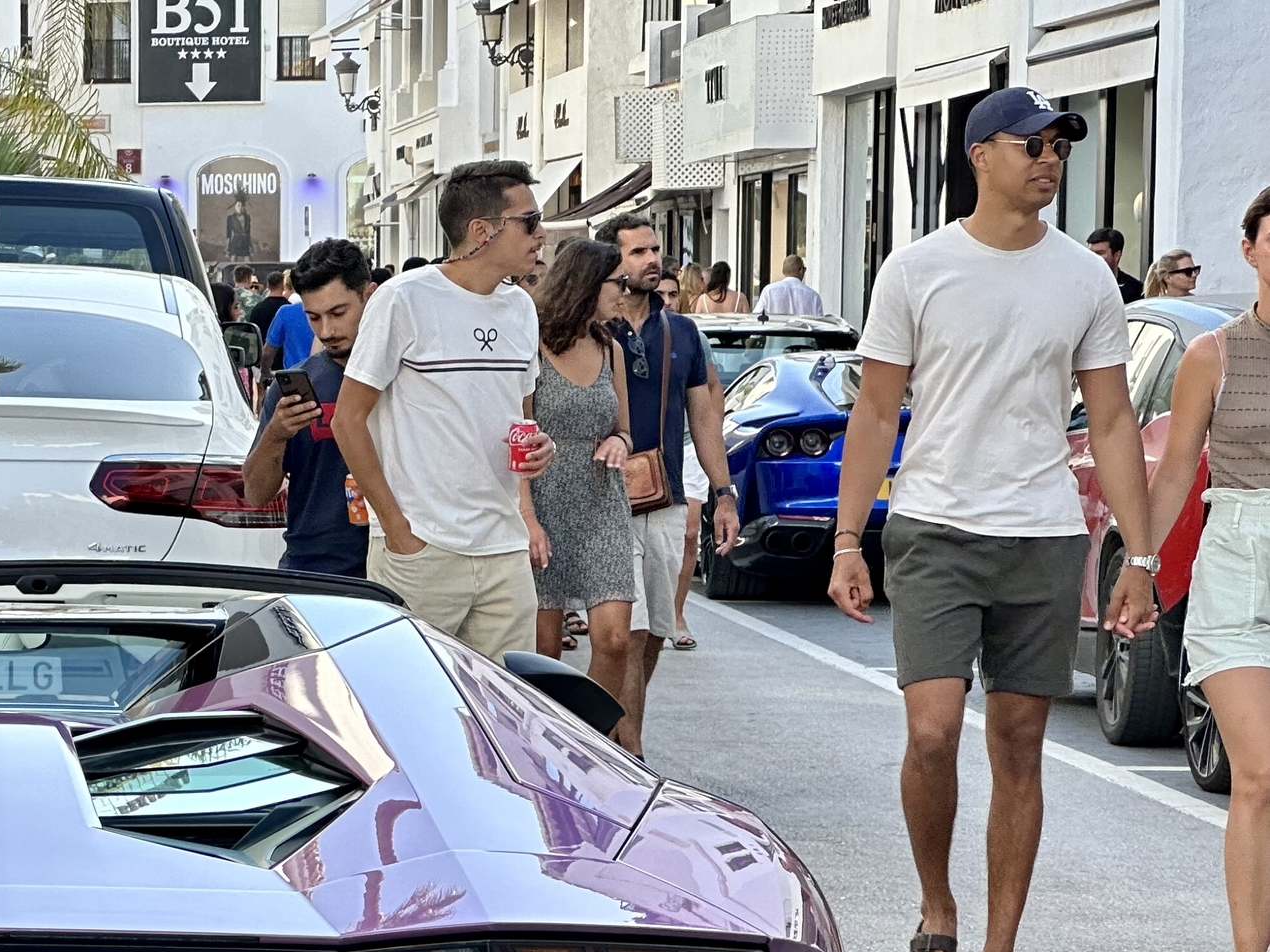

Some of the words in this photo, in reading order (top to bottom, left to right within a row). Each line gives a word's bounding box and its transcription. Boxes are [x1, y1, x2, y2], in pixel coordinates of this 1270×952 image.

[151, 37, 209, 46] BOUTIQUE
[211, 36, 250, 45] HOTEL
[1026, 91, 1054, 111] LA
[125, 163, 133, 174] 8
[201, 172, 277, 195] MOSCHINO
[88, 541, 147, 553] 4MATIC
